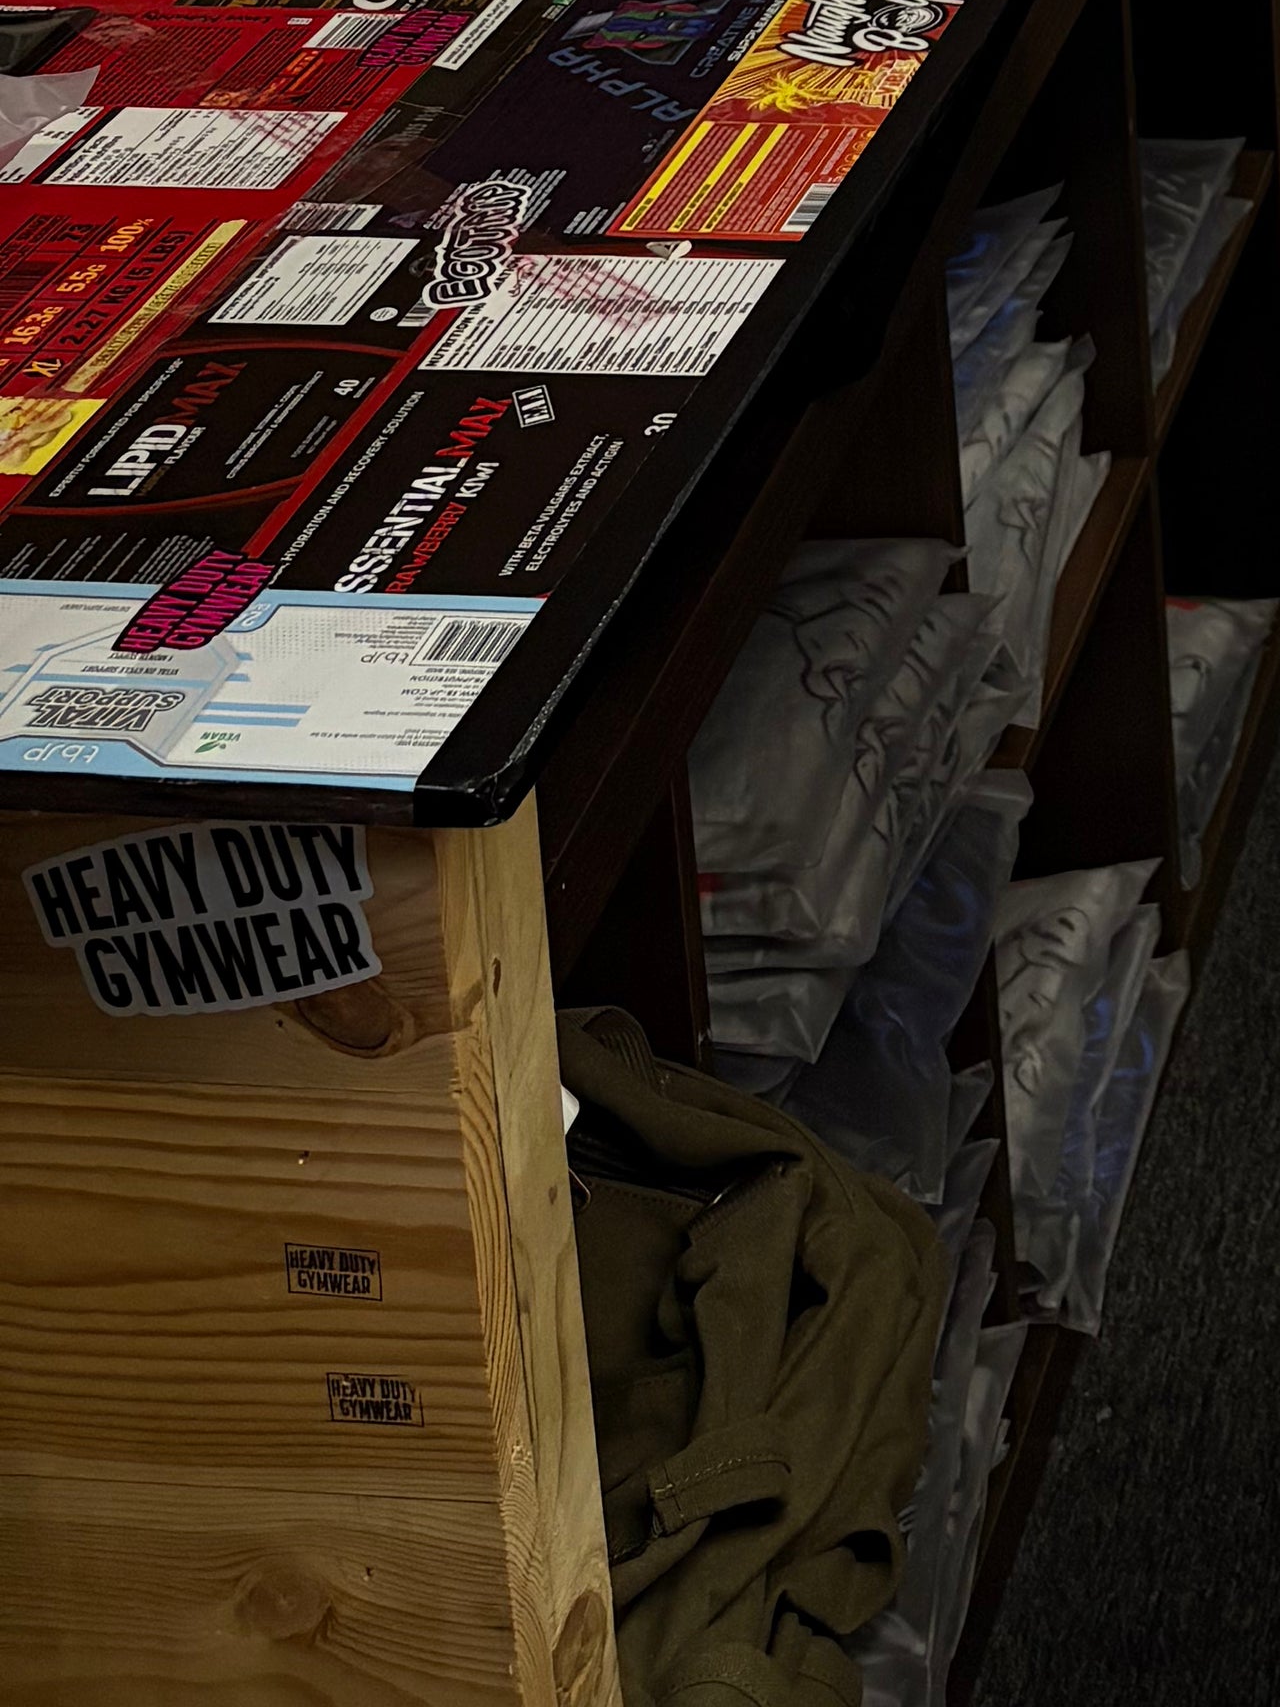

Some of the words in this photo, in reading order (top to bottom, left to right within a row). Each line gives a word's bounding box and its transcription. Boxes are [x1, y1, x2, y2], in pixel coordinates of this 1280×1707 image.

[101, 218, 154, 252] 100%
[22, 359, 62, 378] XL
[333, 378, 361, 397] 40
[164, 426, 207, 466] FLAVOUR
[281, 510, 328, 562] HYDRATION
[327, 483, 350, 511] AND
[343, 436, 388, 483] RECOVERY
[382, 391, 425, 436] SOLUTION
[455, 462, 500, 498] KIWI
[499, 550, 526, 577] WITH
[518, 521, 545, 549] BETA
[536, 476, 577, 523] VULGARIS
[525, 500, 583, 572] ELECTROLYTES
[575, 478, 598, 500] AND
[118, 592, 189, 652] HEAVY
[180, 549, 245, 597] DUTY
[163, 558, 277, 650] GYMWEAR
[28, 686, 186, 712] SUPPORT
[27, 704, 159, 731] VITAL
[200, 731, 241, 742] VEGAN
[31, 829, 208, 939] HEAVY
[208, 824, 366, 910] DUTY
[83, 900, 372, 1010] GYMWEAR
[289, 1247, 336, 1273] HEAVY
[337, 1251, 377, 1276] DUTY
[296, 1267, 372, 1296] GYMWEAR
[330, 1377, 377, 1401] HEAVY
[379, 1378, 419, 1404] DUTY
[337, 1396, 415, 1423] GYMWEAR
